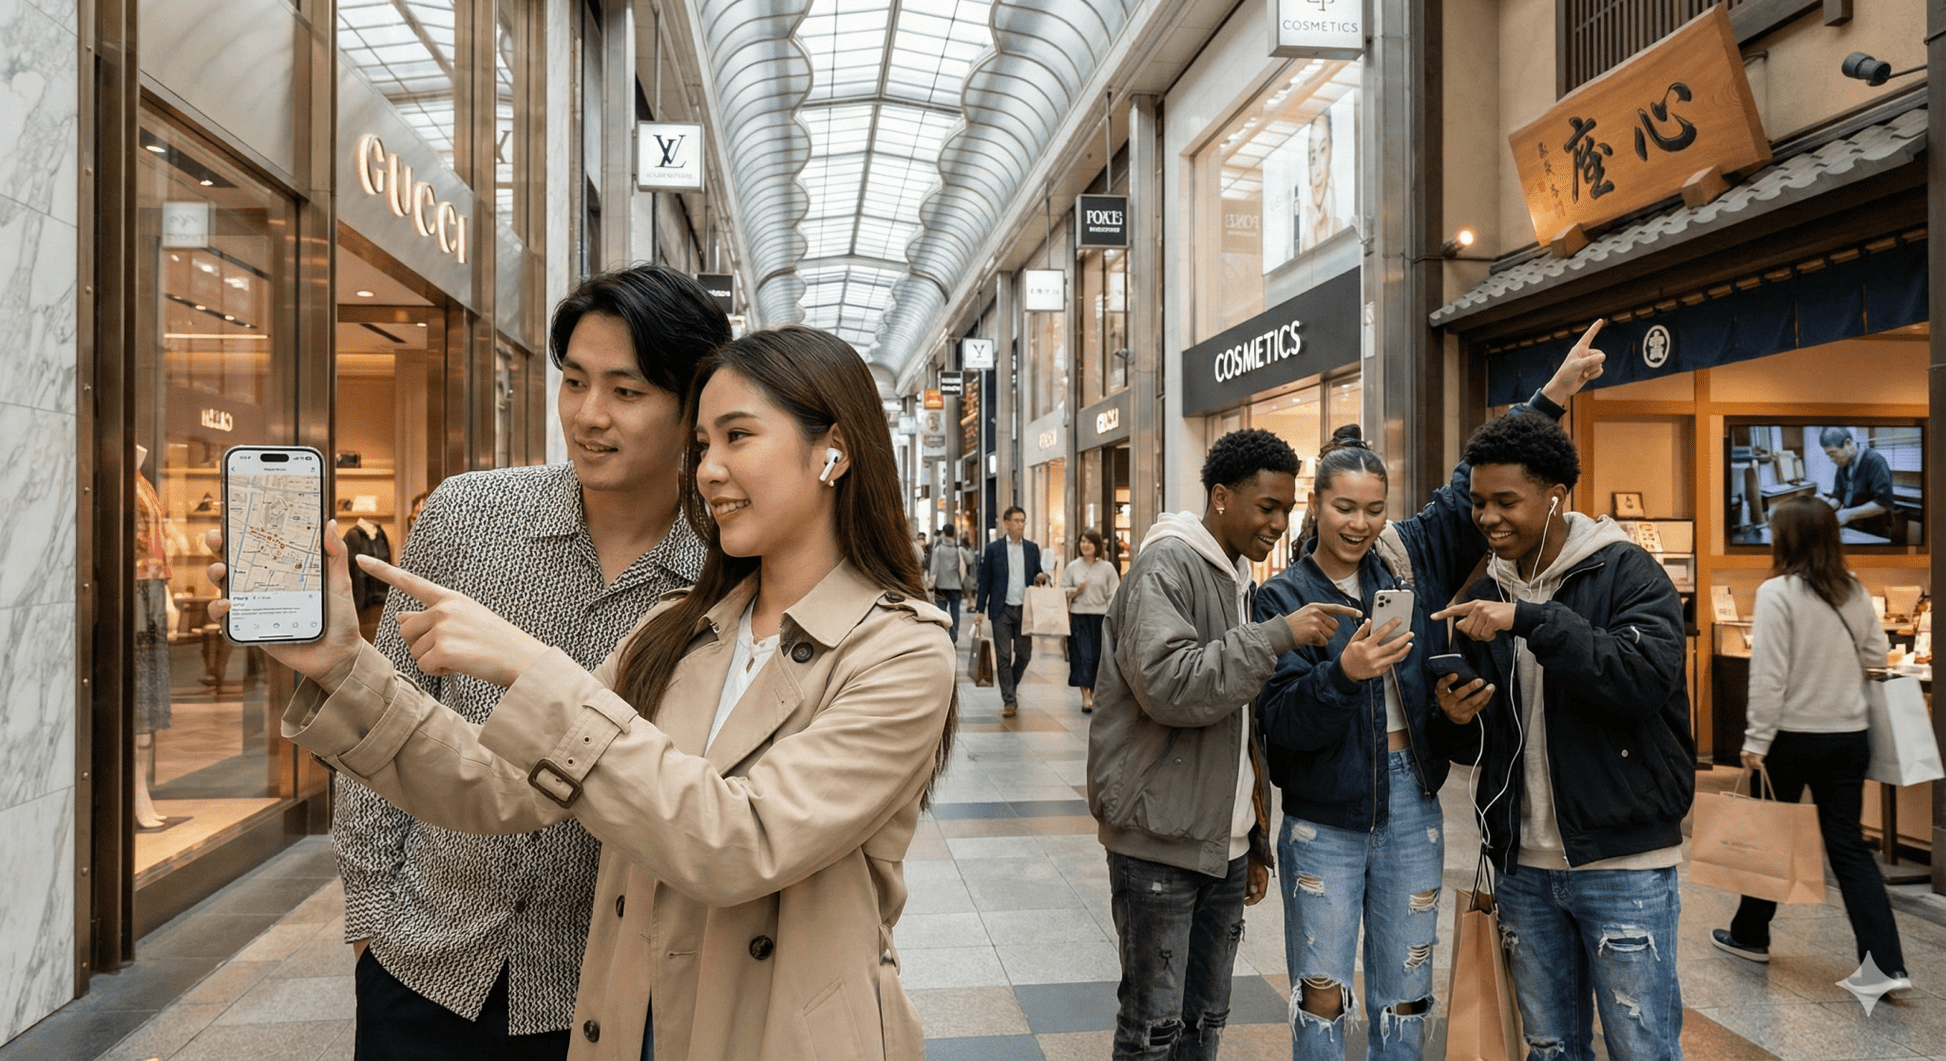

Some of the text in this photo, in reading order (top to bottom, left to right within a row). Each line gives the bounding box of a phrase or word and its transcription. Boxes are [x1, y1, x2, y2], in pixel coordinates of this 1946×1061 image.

[1282, 19, 1359, 33] COSMETICS
[358, 133, 467, 264] GUCCI
[1214, 320, 1301, 383] COSMETICS
